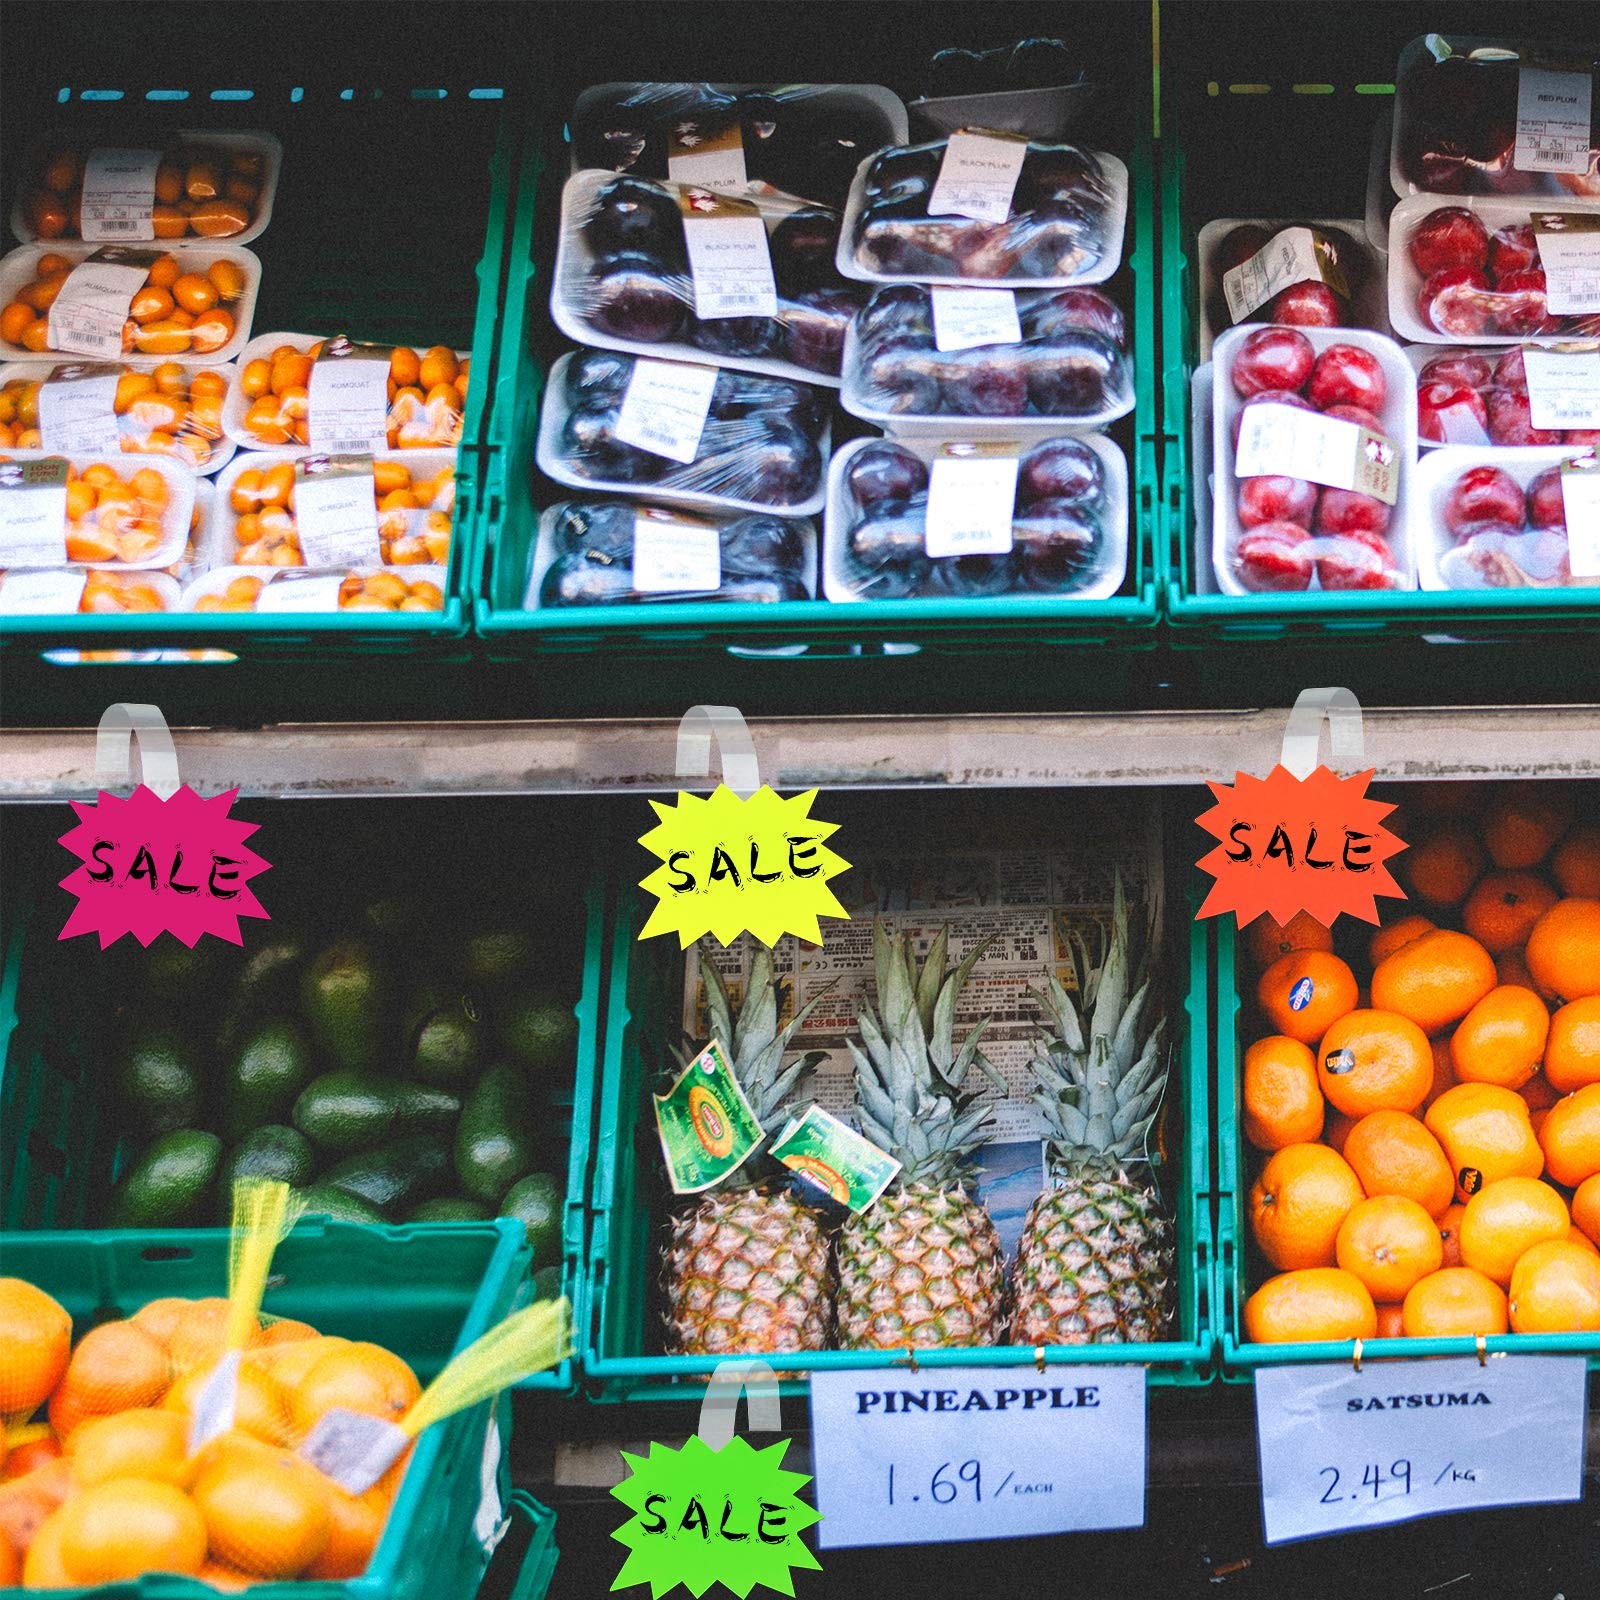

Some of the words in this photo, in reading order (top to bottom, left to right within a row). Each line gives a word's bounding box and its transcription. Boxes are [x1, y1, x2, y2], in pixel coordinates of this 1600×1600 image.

[1538, 94, 1555, 102] RED
[86, 839, 243, 900] SALE
[667, 835, 824, 895] SALE
[1224, 821, 1376, 873] SALE
[856, 1386, 1101, 1414] PINEAPPLE
[1346, 1391, 1493, 1413] SATSUMA
[888, 1459, 982, 1506] 1.69
[1319, 1459, 1412, 1504] 2.49
[639, 1493, 792, 1545] SALE
